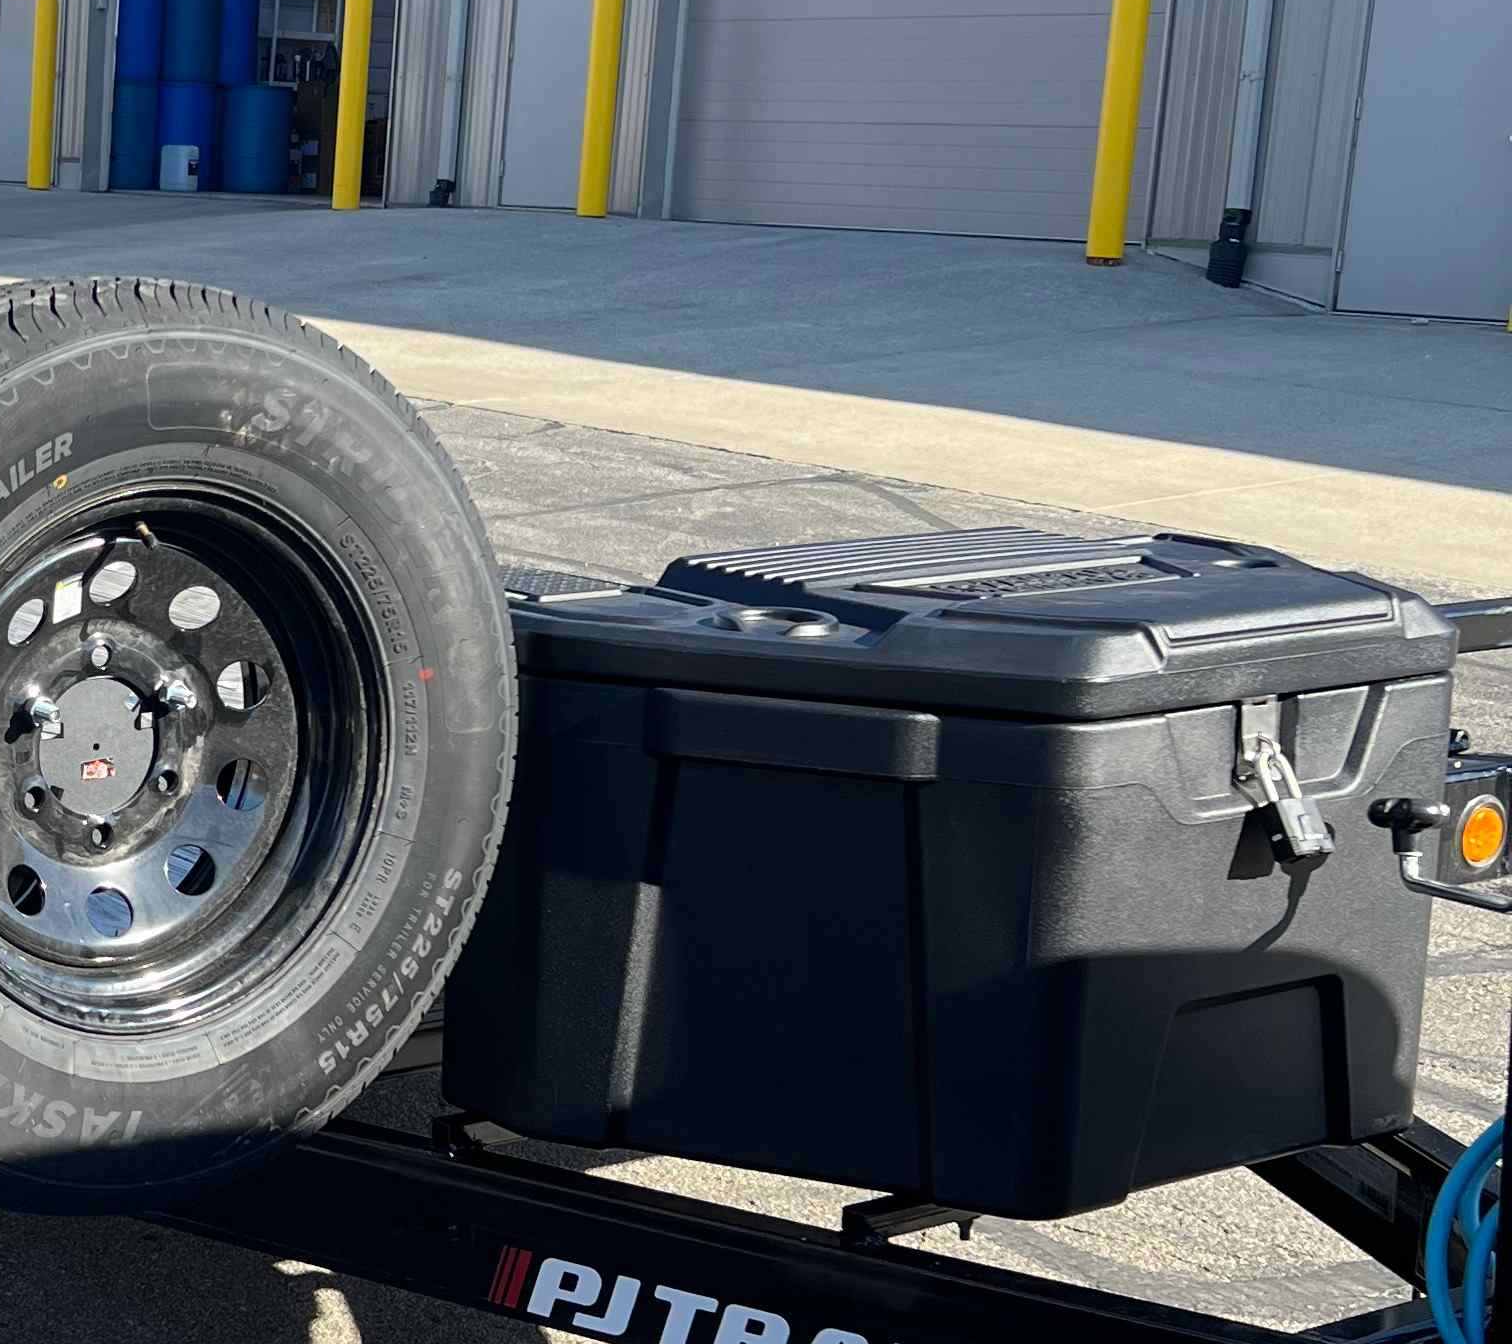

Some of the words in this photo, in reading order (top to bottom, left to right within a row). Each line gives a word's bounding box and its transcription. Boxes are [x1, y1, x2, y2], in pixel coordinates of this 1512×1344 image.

[419, 871, 437, 899] FOR
[387, 907, 423, 960] TRAILER
[317, 867, 463, 1075] ST225/75R15
[345, 963, 387, 1014] SERVICE
[317, 1014, 344, 1043] ONLY
[526, 1257, 642, 1336] PJ
